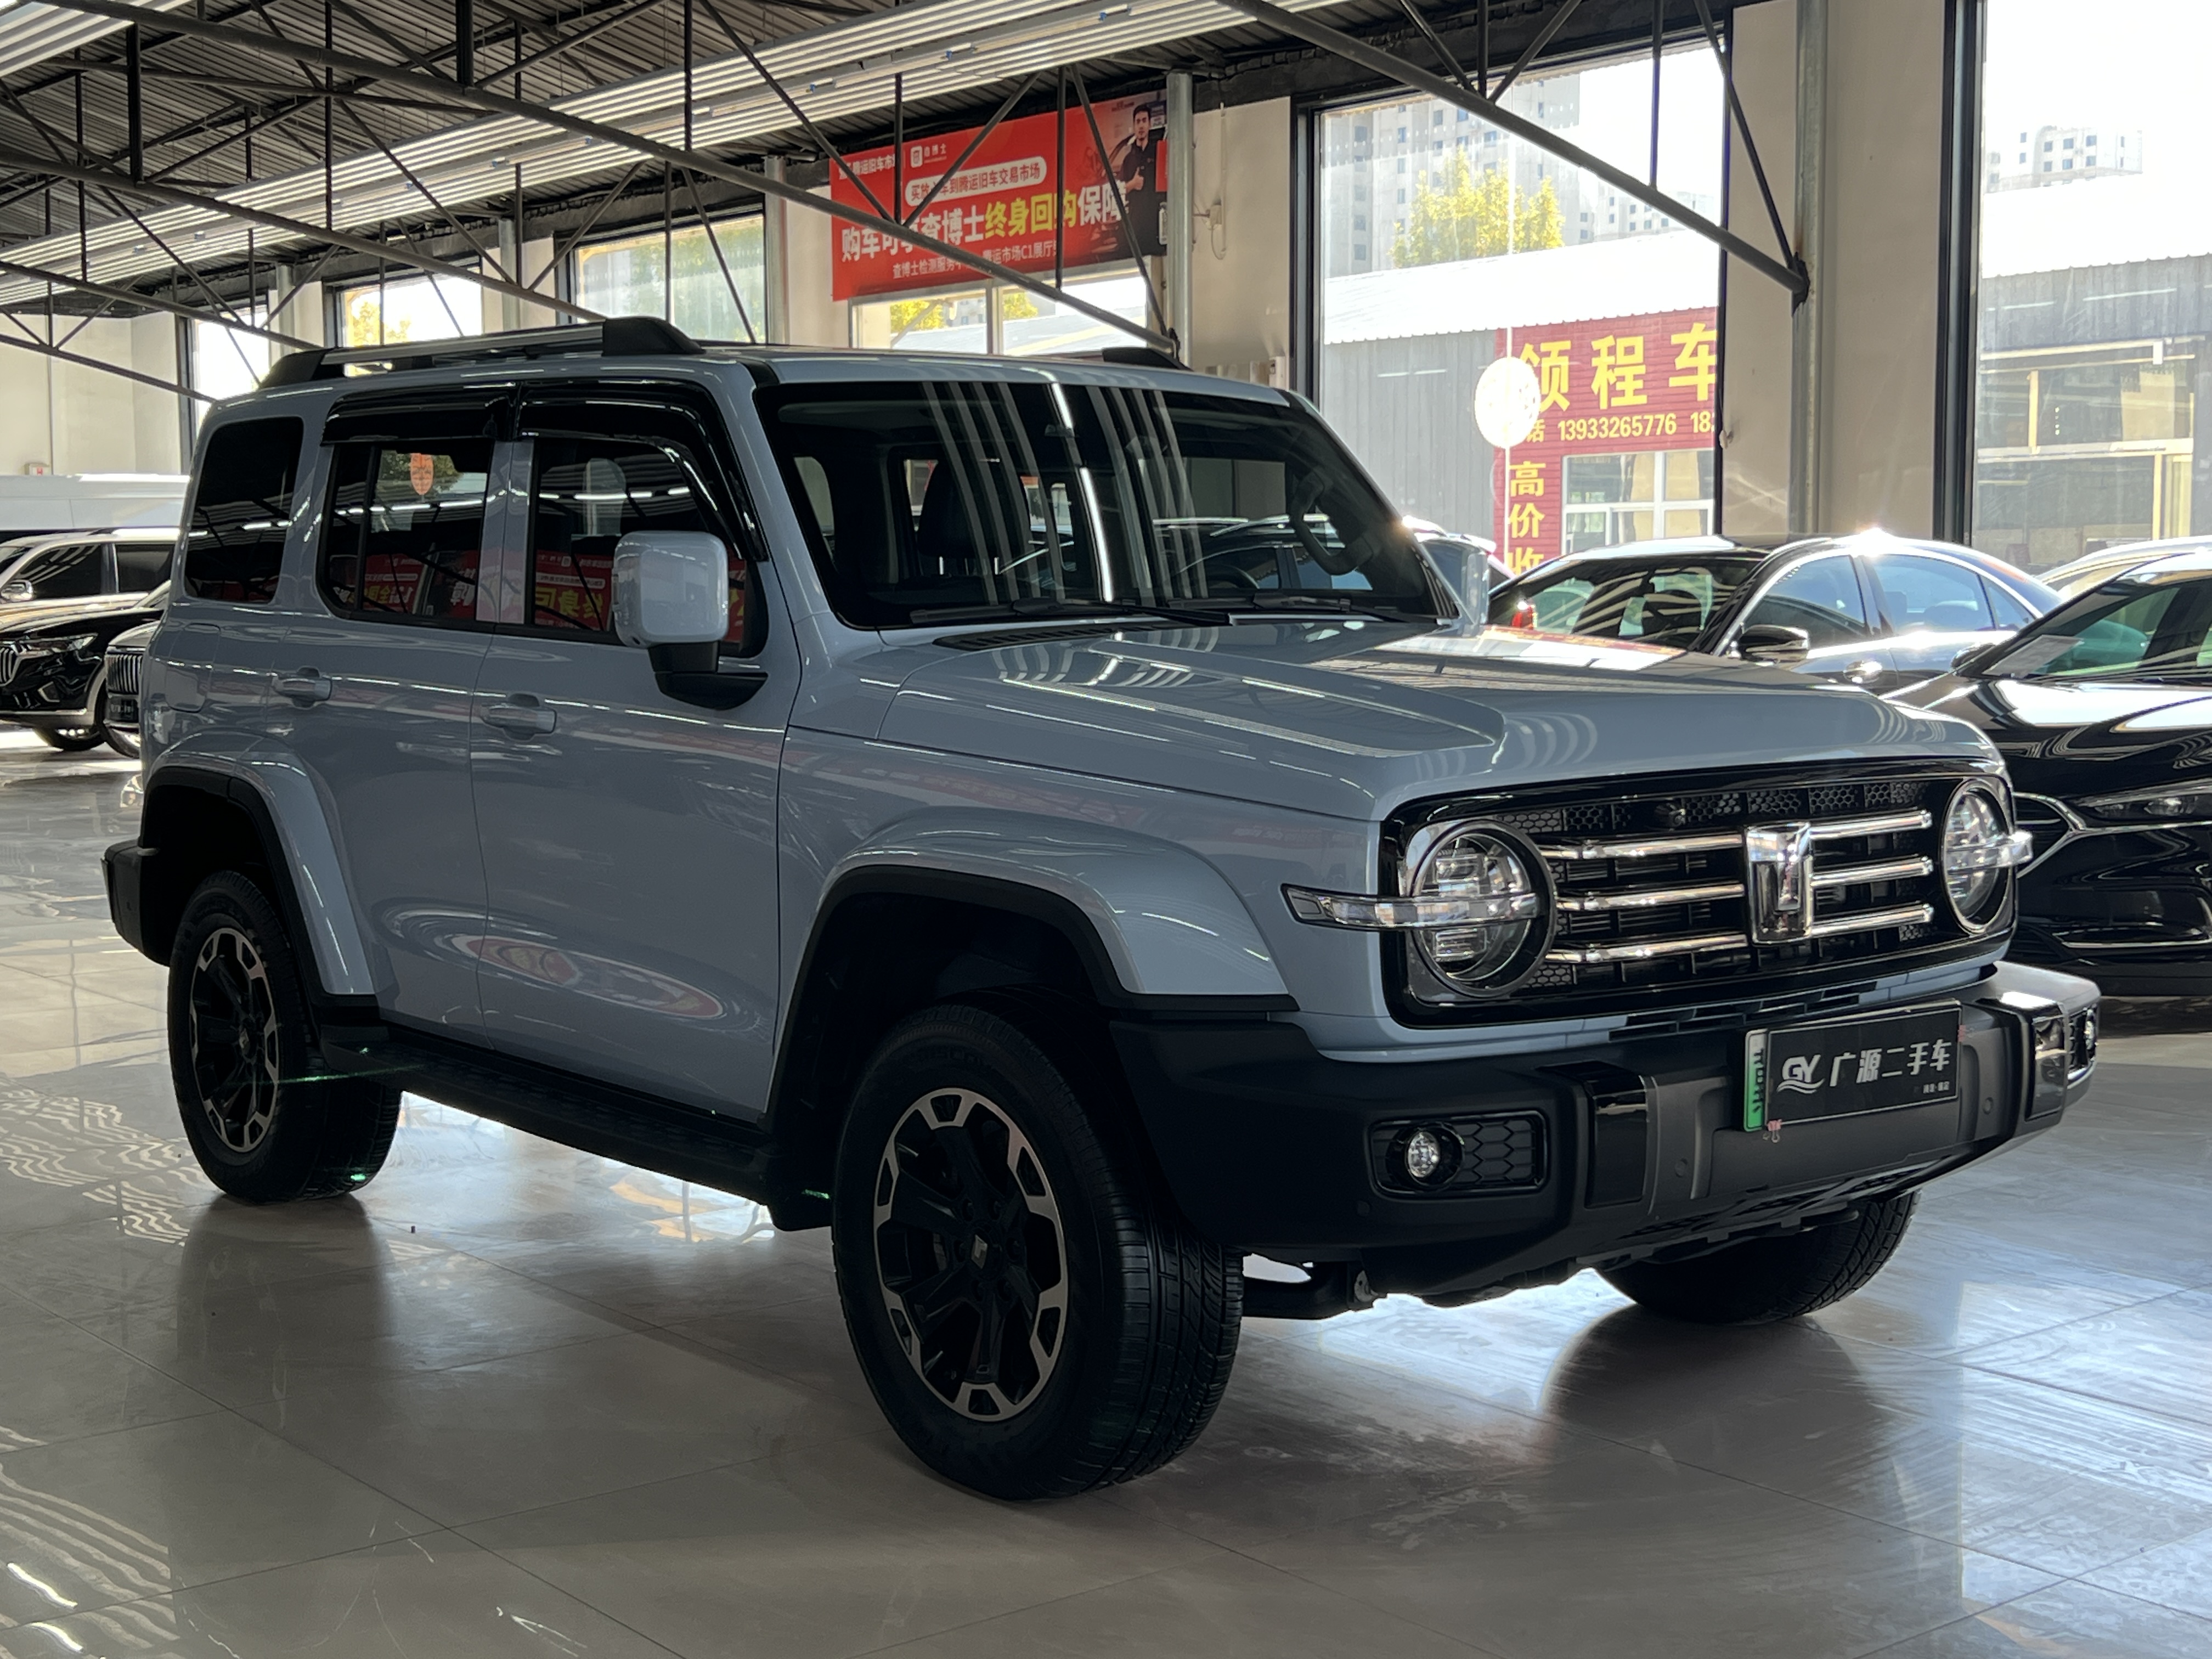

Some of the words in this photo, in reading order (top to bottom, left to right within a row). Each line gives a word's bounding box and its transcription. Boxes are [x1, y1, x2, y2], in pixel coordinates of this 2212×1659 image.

[1558, 413, 1677, 441] 13933265776
[1829, 1038, 1952, 1087] 广源二手车
